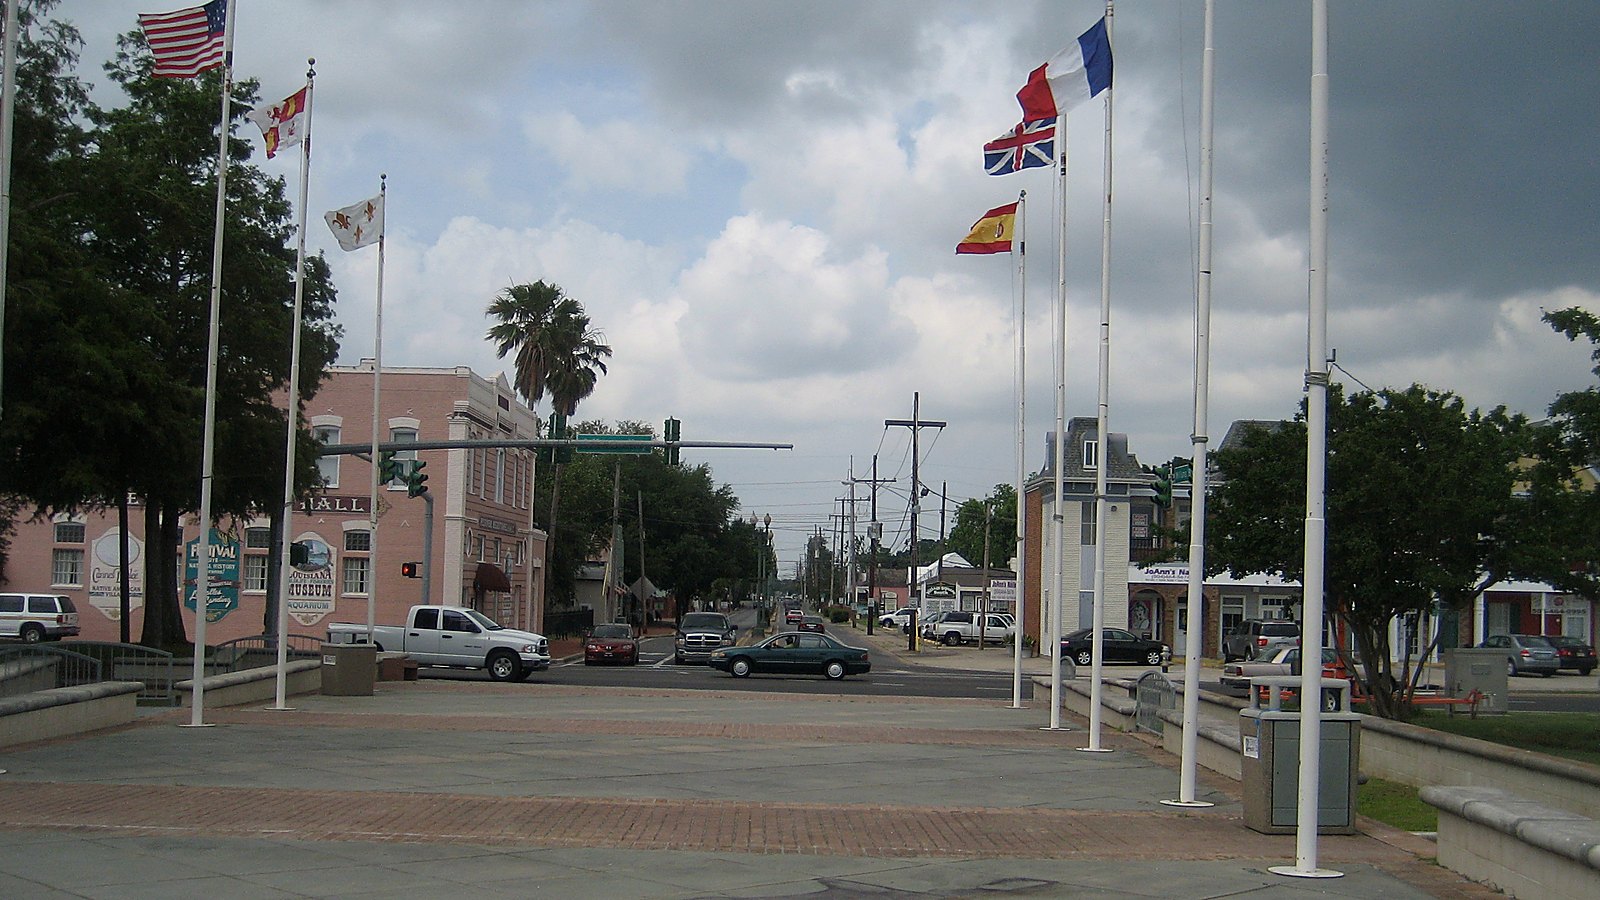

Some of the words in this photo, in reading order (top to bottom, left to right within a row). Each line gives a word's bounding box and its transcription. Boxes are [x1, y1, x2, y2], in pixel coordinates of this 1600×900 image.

[300, 497, 364, 512] HALL
[191, 543, 236, 559] FTIVAL
[288, 584, 332, 597] MUSEUM
